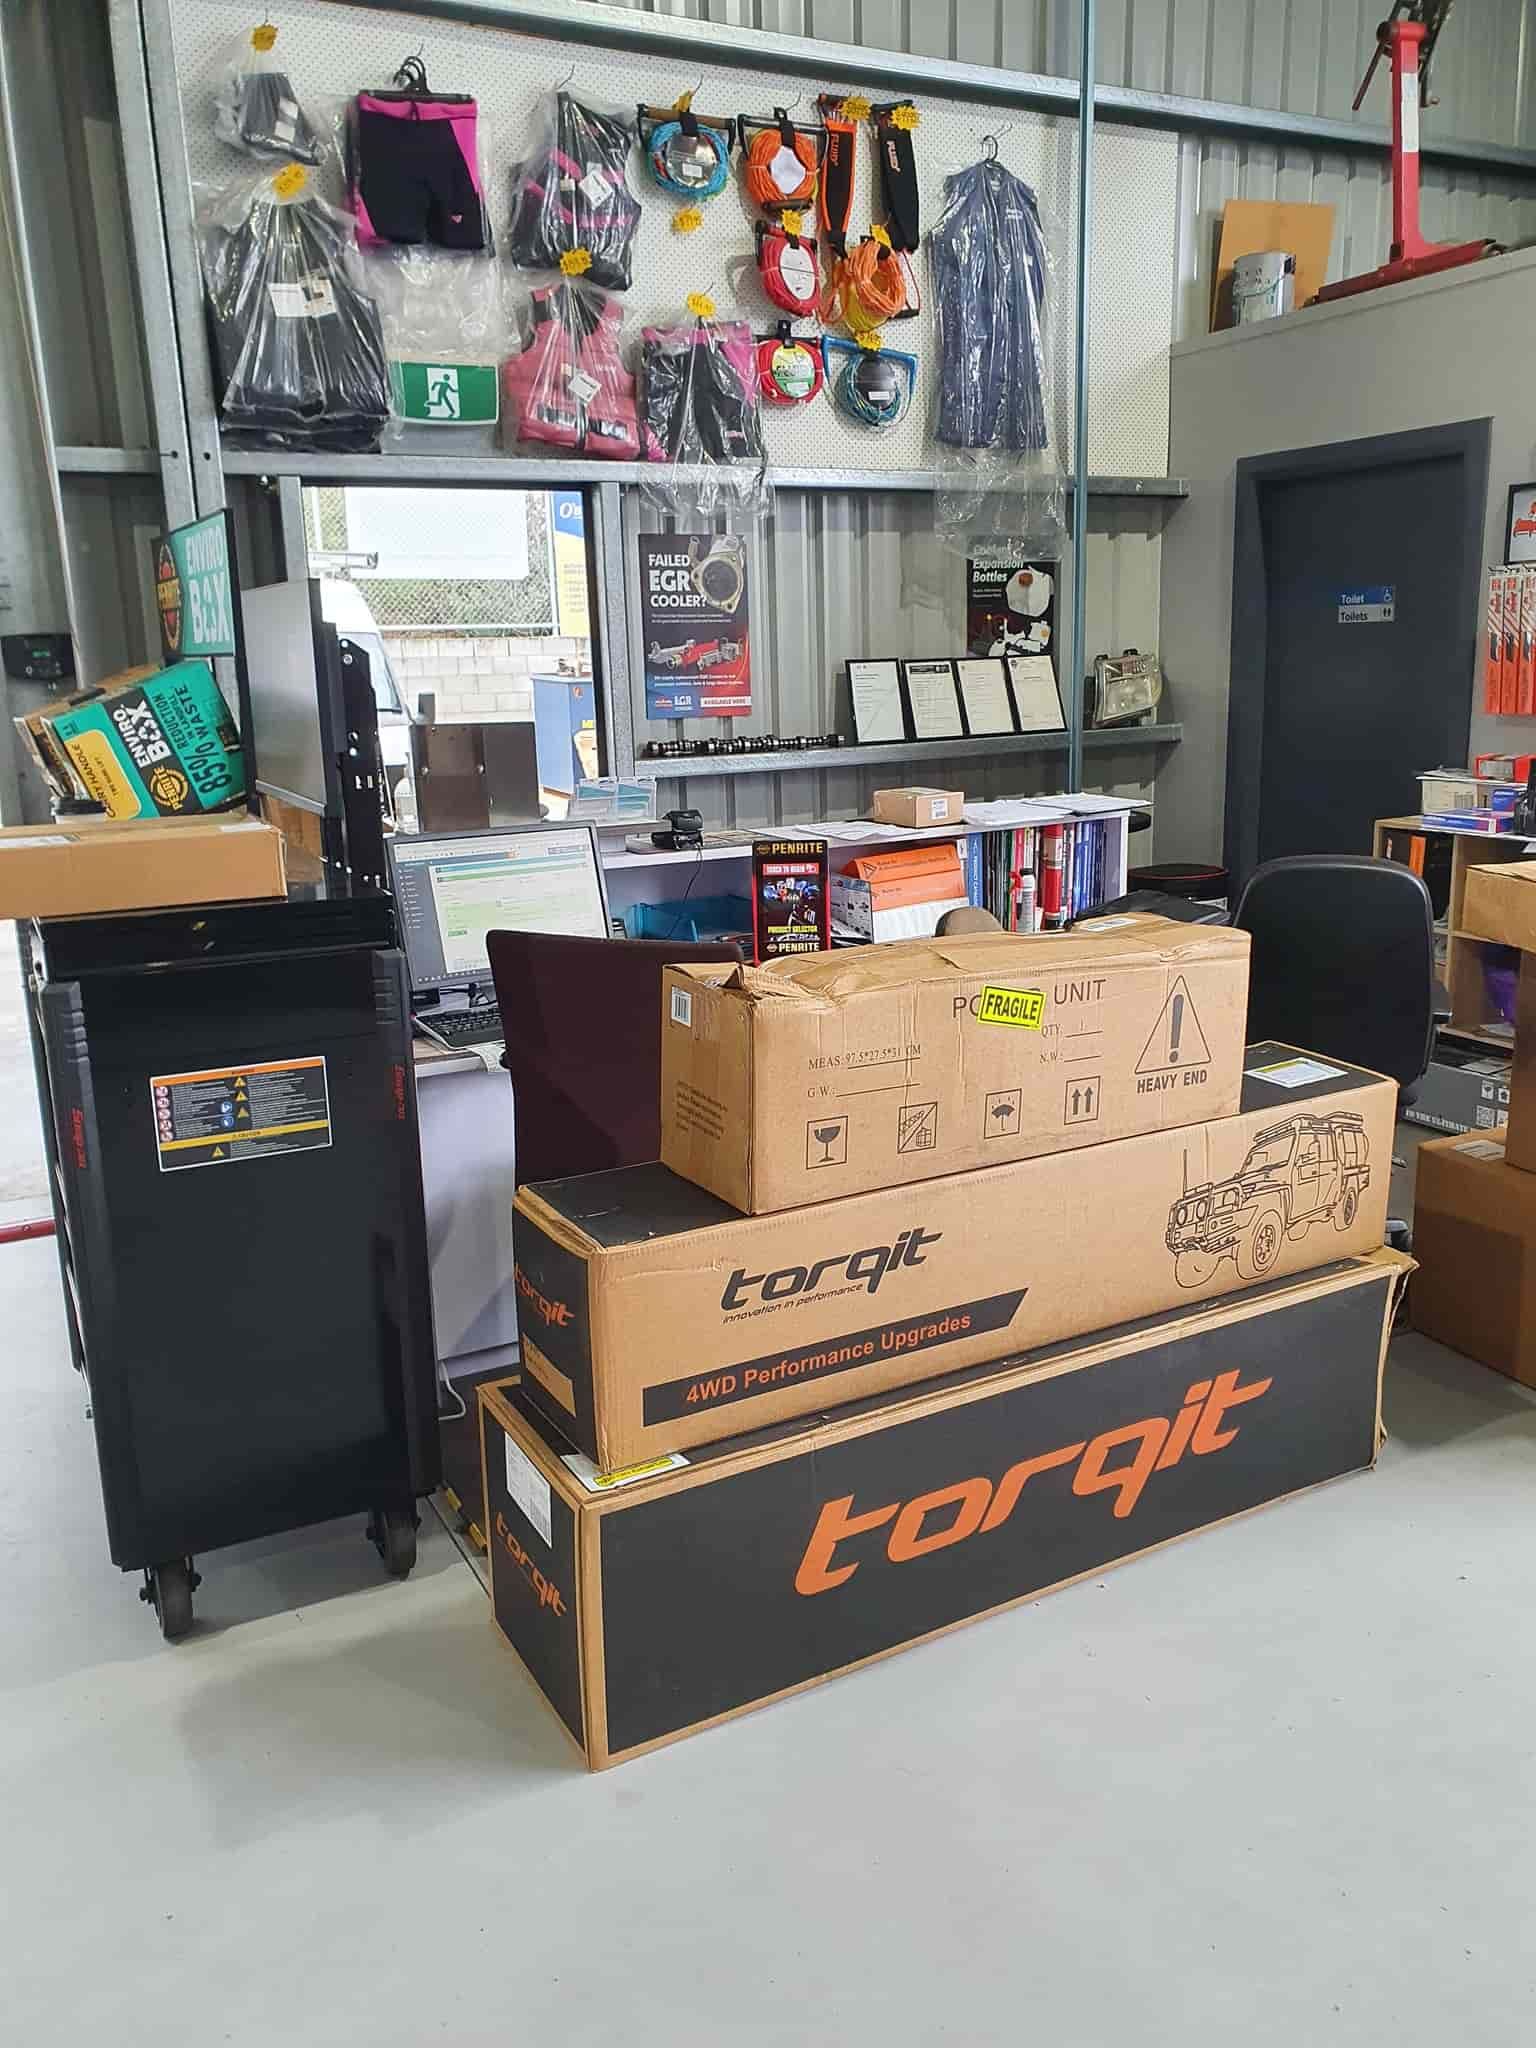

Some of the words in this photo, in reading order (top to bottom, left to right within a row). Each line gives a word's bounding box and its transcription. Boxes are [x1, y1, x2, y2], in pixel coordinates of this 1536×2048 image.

[185, 525, 225, 577] ENVIRO
[648, 554, 690, 567] FAILED
[973, 559, 1024, 572] Expansion
[648, 569, 692, 592] EGR
[973, 571, 1008, 583] Bottles
[650, 594, 707, 608] COOLER?
[1341, 594, 1365, 604] Toilet
[1341, 611, 1369, 621] Toilets
[152, 692, 188, 750] REDUCTION
[174, 683, 209, 738] WASTE
[113, 708, 153, 768] ENVIRO
[125, 700, 172, 762] BOX
[72, 743, 99, 785] HANDLE
[184, 741, 233, 794] 85%
[153, 764, 184, 811] PENRITE
[772, 842, 824, 854] PENRITE
[779, 942, 820, 953] PENRITE
[984, 993, 1039, 1020] FRAGILE
[1053, 979, 1106, 1005] UNIT
[1041, 1024, 1063, 1038] QTY:
[808, 1054, 845, 1071] MEAS:
[1136, 1074, 1178, 1094] HEAVY
[1183, 1070, 1208, 1086] END
[721, 1227, 943, 1311] torqit
[514, 1262, 576, 1327] torqit
[722, 1303, 782, 1324] innovation
[784, 1299, 794, 1309] in
[795, 1283, 863, 1309] performance
[685, 1374, 736, 1403] 4WD
[744, 1341, 874, 1389] Performance
[880, 1313, 971, 1352] Upgrades
[795, 1368, 1273, 1596] torqit
[496, 1512, 567, 1616] torqit
